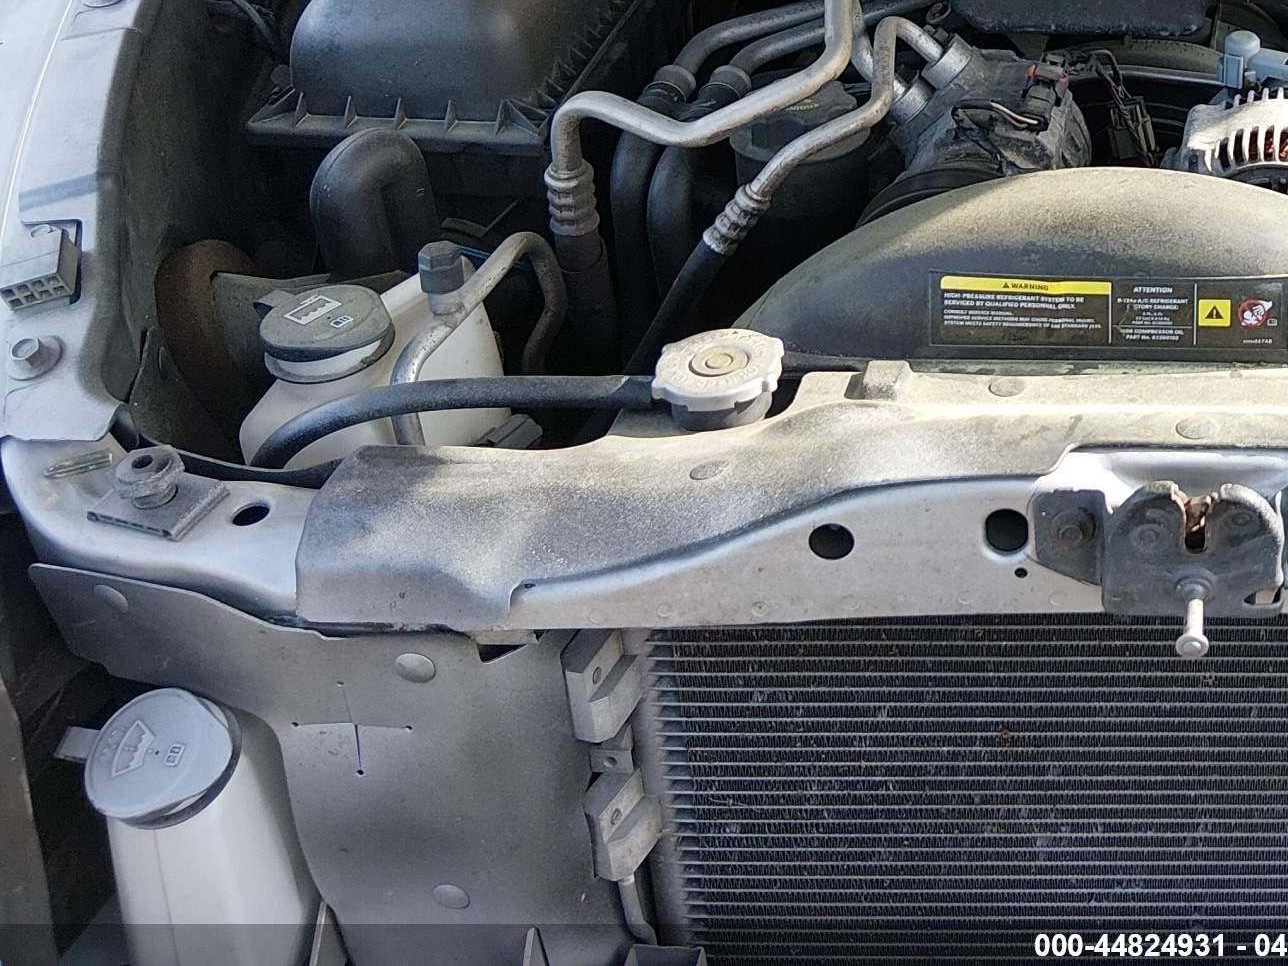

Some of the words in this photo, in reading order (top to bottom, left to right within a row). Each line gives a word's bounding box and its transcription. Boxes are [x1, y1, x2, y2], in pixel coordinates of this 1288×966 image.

[1011, 282, 1049, 291] WARNING
[996, 294, 1039, 302] REFRIGERANT
[1019, 302, 1057, 310] PERSONNEL
